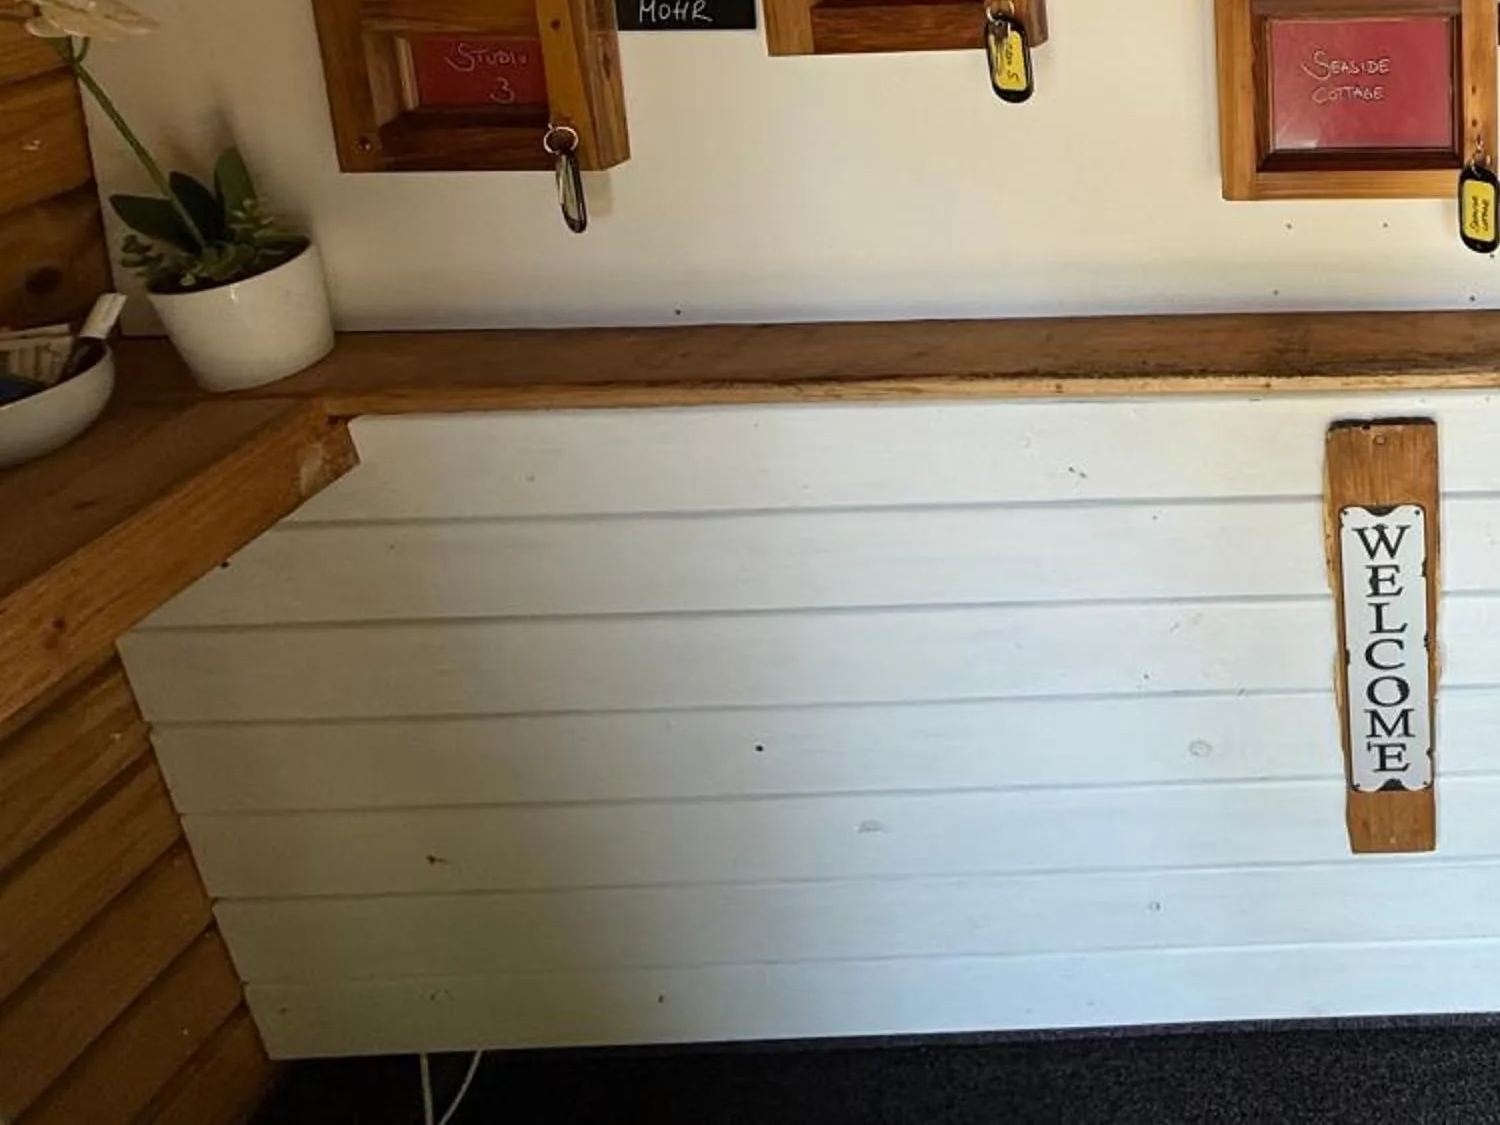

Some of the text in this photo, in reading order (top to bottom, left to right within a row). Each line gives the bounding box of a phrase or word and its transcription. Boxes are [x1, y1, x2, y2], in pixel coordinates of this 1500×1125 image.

[1303, 50, 1390, 81] SEASIDE
[489, 77, 515, 104] 3
[1311, 85, 1385, 105] COTTAGE
[1351, 523, 1416, 773] WELCOME
